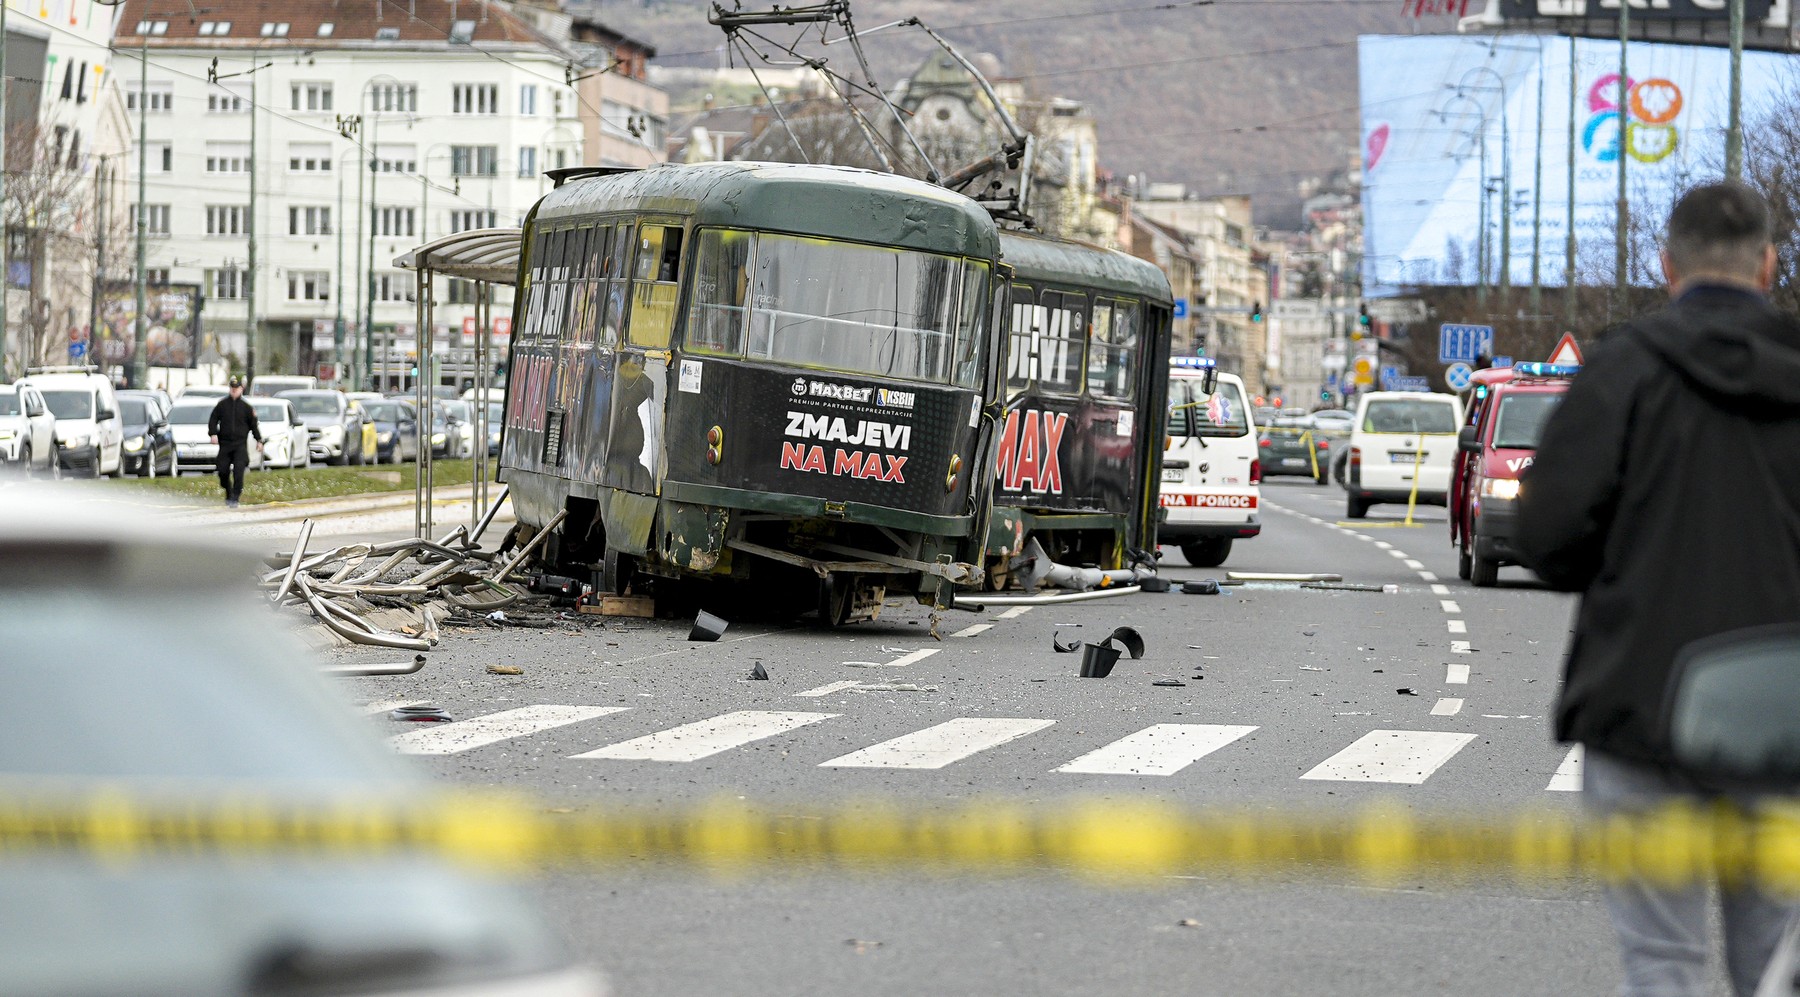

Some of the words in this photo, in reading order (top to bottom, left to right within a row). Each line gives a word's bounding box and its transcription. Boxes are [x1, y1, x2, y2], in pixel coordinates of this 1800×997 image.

[1008, 303, 1071, 384] JEVI
[789, 397, 820, 406] PREMIUM
[823, 402, 854, 411] PARTNER
[857, 406, 913, 418] REPREZENTACIJE
[887, 390, 915, 407] KSBIH
[784, 411, 912, 450] ZMAJEVI
[780, 441, 827, 474] NA
[832, 448, 909, 484] MAX
[1506, 455, 1537, 473] VA
